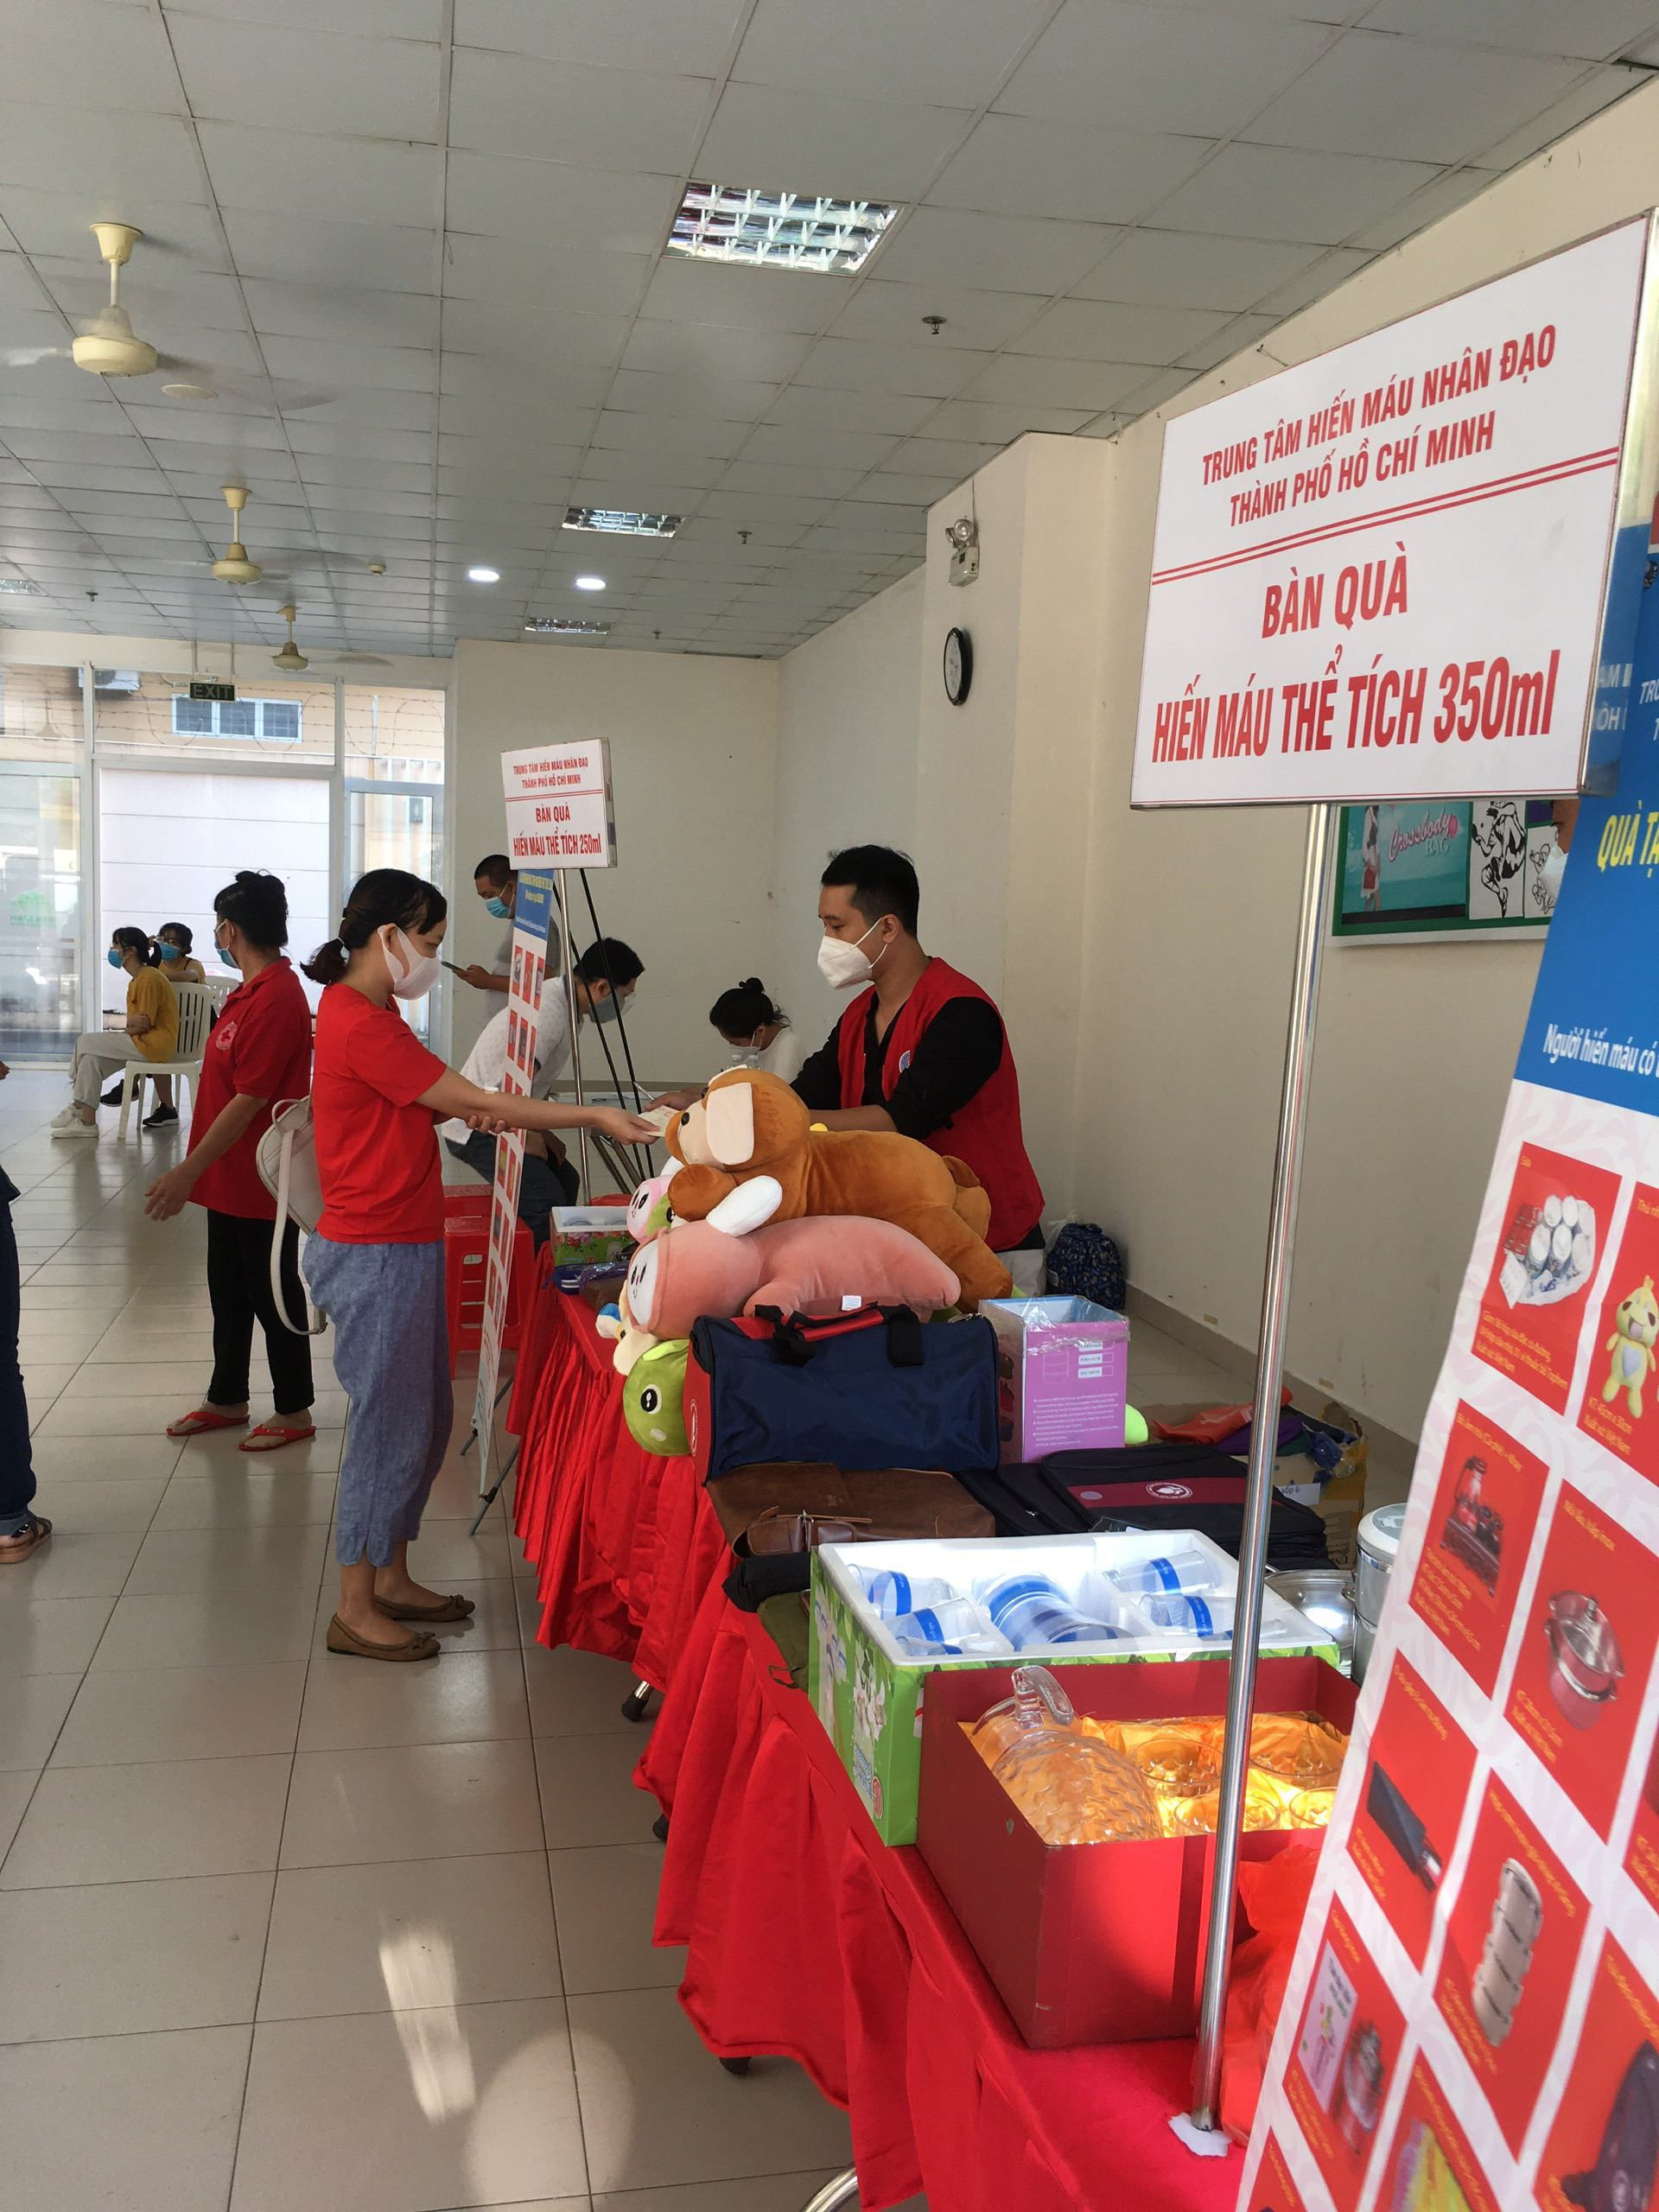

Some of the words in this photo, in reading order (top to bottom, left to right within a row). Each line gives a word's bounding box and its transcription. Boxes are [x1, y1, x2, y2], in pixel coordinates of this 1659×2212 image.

[1203, 436, 1258, 485] TRUNG
[1264, 418, 1302, 464] TÂM
[1306, 389, 1356, 448] HIẾN
[1361, 373, 1414, 429] MÁU
[1421, 346, 1492, 409] NHÂN
[1499, 325, 1556, 383] ĐẠO
[1230, 480, 1288, 527] THÀNH
[1292, 448, 1337, 507] PHỐ
[1338, 437, 1370, 493] HỒ
[1376, 424, 1422, 482] CHÍ
[1426, 410, 1496, 467] MINH
[1262, 566, 1325, 639] BÀN
[1333, 541, 1408, 632] QUÀ
[192, 683, 232, 700] EXIT
[1152, 674, 1211, 763] HIẾN
[1212, 672, 1274, 760] MÁU
[1281, 644, 1344, 754] THỂ
[1346, 654, 1428, 750] TÍCH
[1433, 649, 1561, 745] 350ml
[513, 764, 528, 776] TRUNG
[536, 804, 551, 823] BÀN
[553, 802, 571, 823] QUÀ
[1388, 807, 1452, 862] Crossbody
[1597, 799, 1643, 874] QUÀ
[513, 830, 528, 857] HIẾN
[529, 832, 545, 856] MÁU
[546, 826, 560, 855] THỂ
[561, 830, 579, 855] TÍCH
[580, 833, 602, 855] 250ml
[1425, 838, 1450, 856] BAG
[1542, 1023, 1585, 1064] Người
[1580, 1027, 1609, 1065] hiến
[1608, 1036, 1640, 1072] máu
[1638, 1040, 1658, 1076] có
